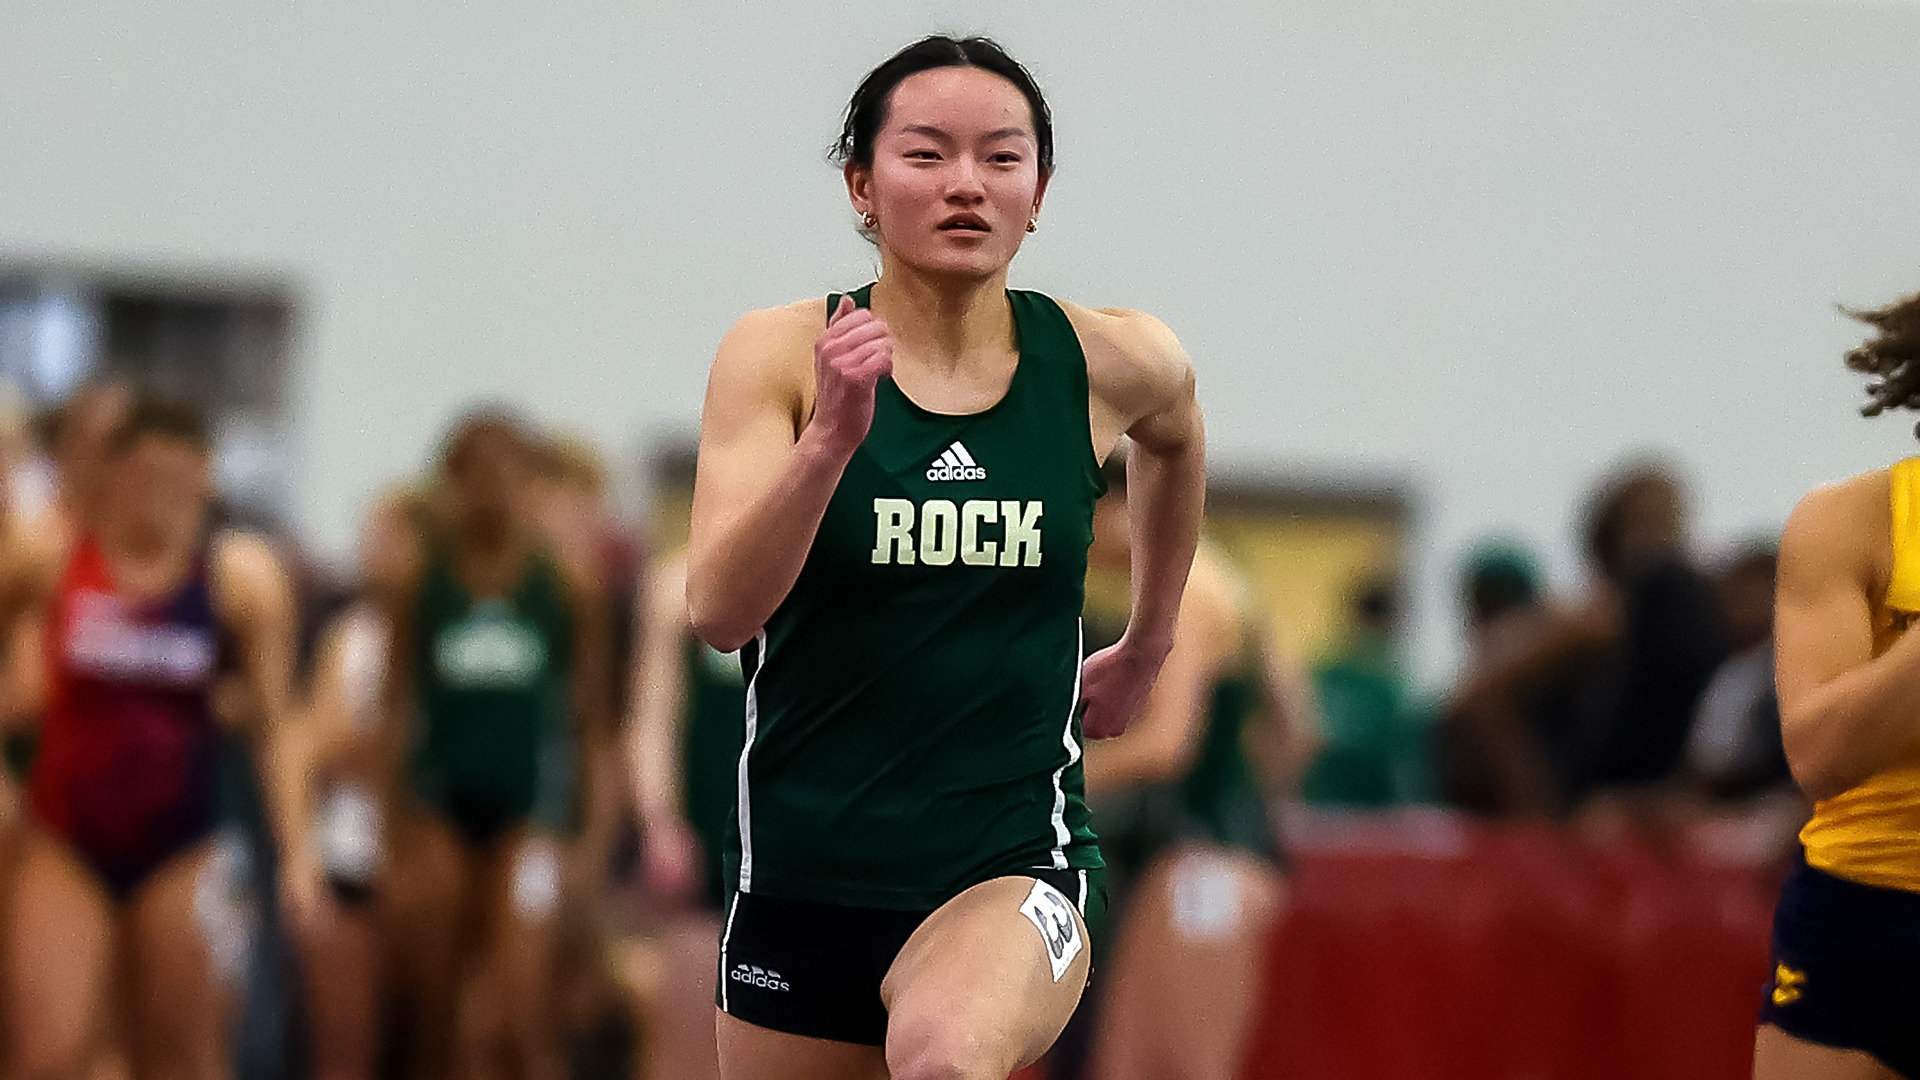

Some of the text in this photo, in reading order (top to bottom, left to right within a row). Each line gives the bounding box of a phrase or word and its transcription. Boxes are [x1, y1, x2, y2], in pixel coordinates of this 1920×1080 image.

[926, 466, 986, 481] adidas
[871, 498, 1043, 567] ROCK
[731, 969, 789, 991] adidas
